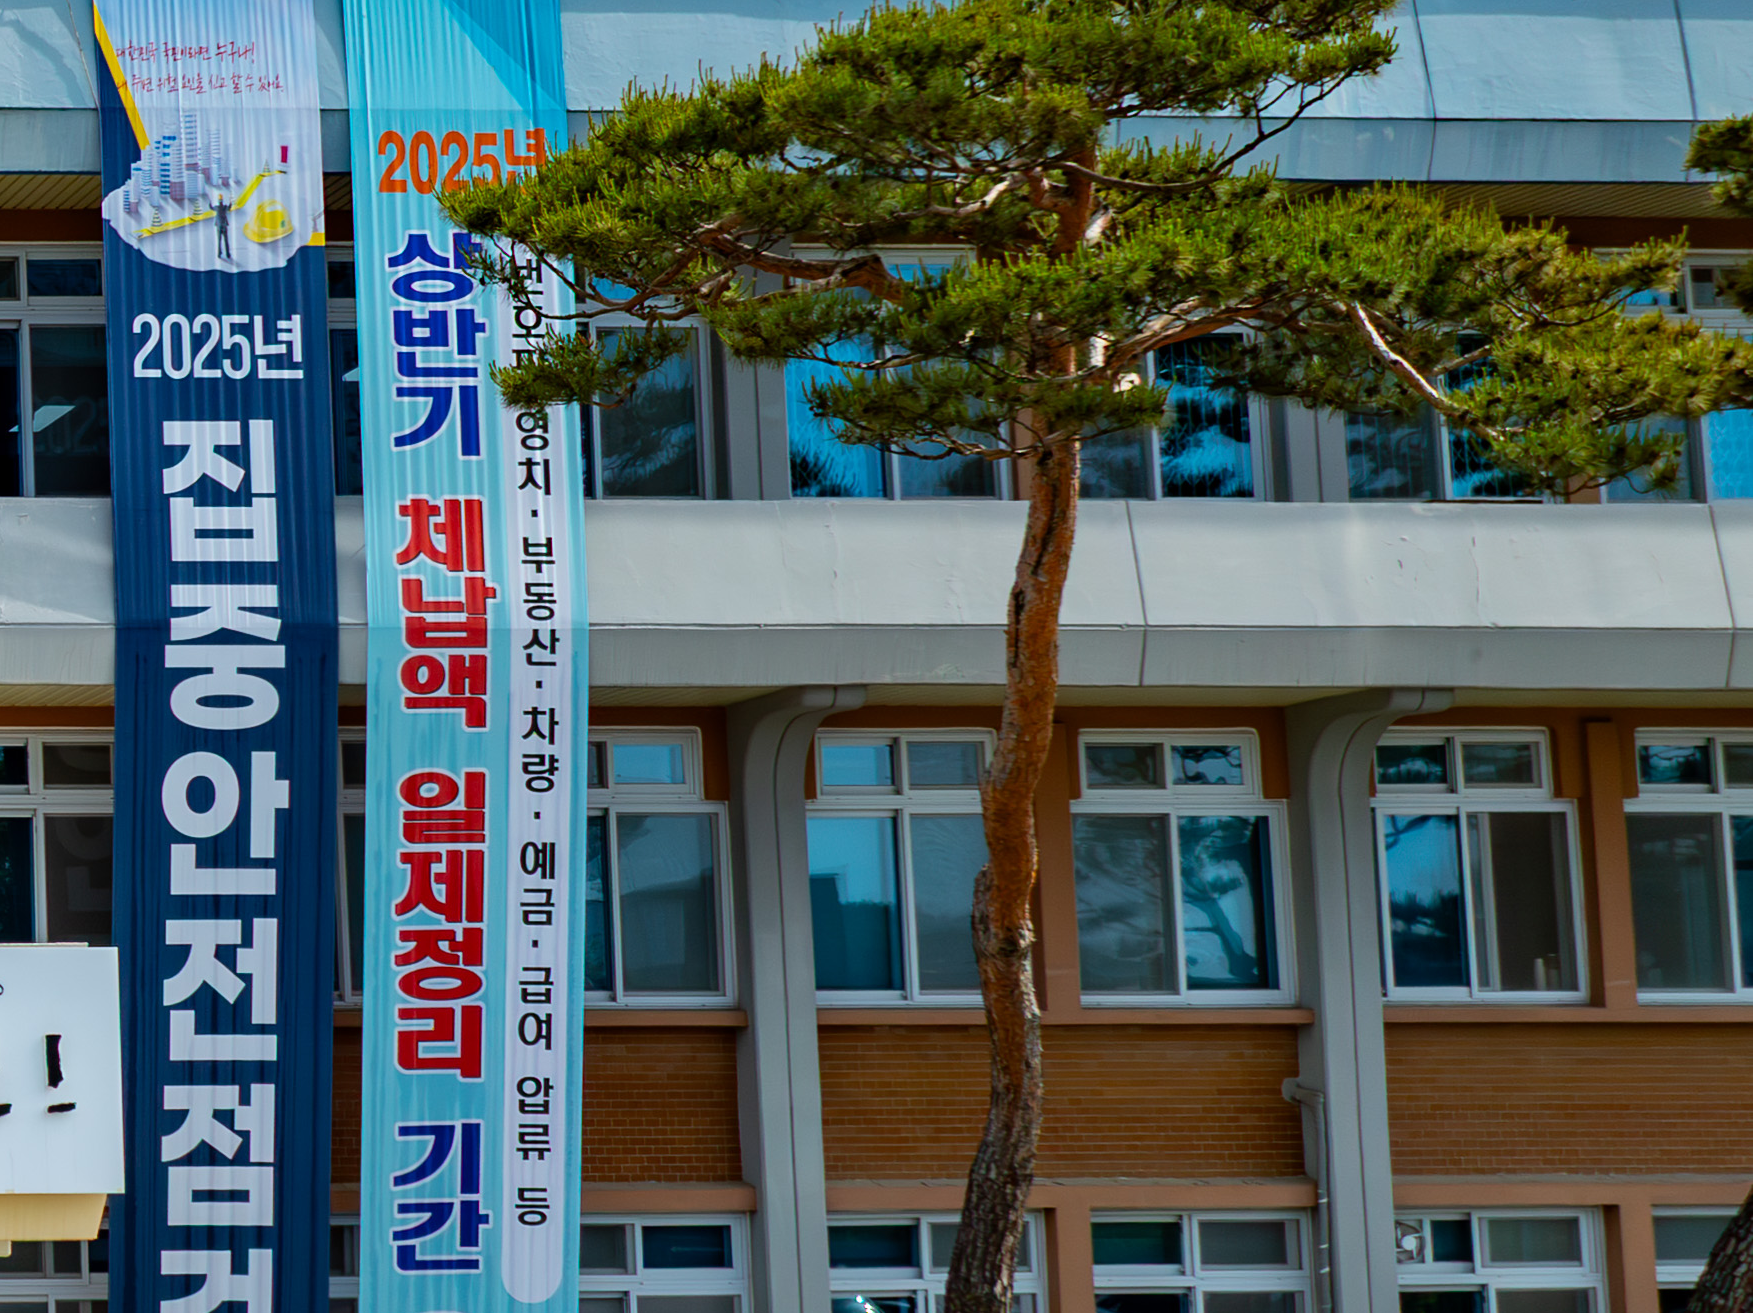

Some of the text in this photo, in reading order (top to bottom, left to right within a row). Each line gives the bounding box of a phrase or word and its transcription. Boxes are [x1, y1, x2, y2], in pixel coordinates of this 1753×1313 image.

[215, 41, 256, 64] 누구나!
[378, 129, 548, 195] 2025년
[133, 312, 304, 381] 2025년
[389, 232, 489, 459] 상반기
[396, 497, 495, 731] 체납액
[392, 767, 490, 1082] 일제정리
[516, 1077, 554, 1162] 압류
[392, 1121, 494, 1274] 기간
[515, 1186, 551, 1227] 등
